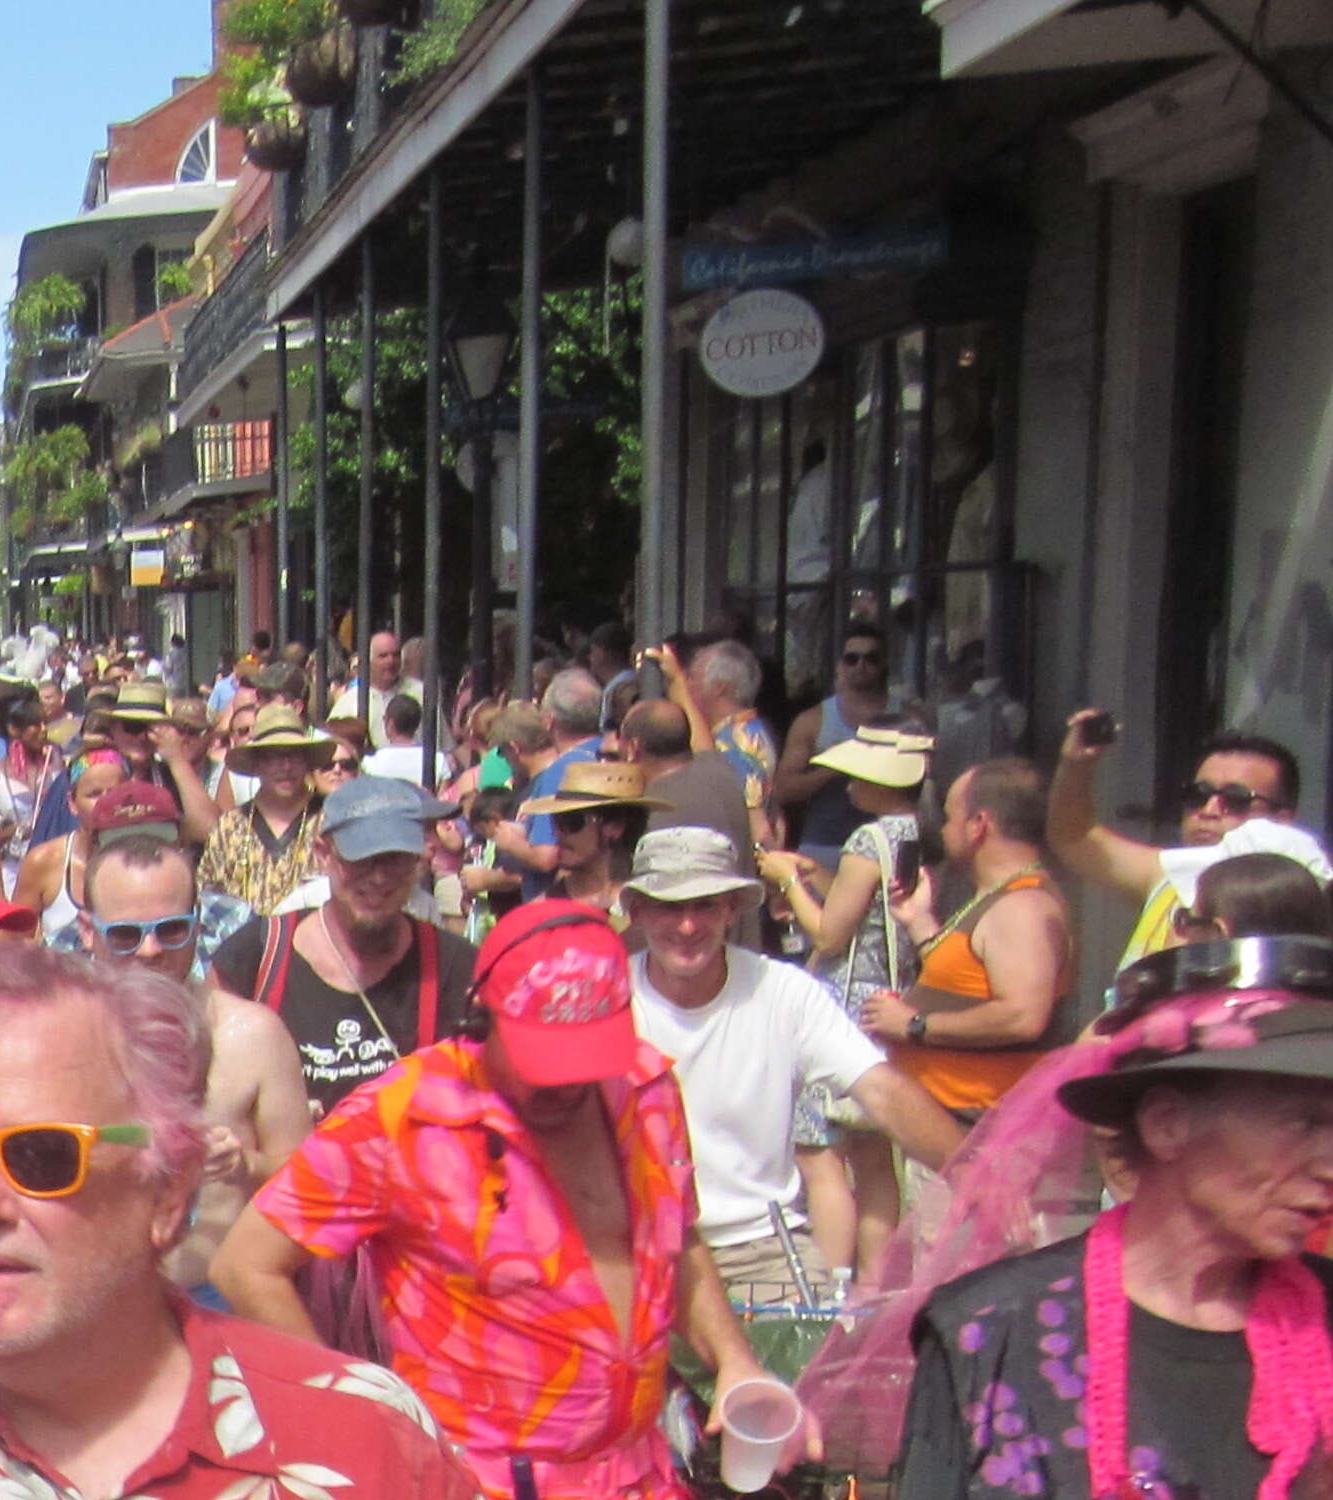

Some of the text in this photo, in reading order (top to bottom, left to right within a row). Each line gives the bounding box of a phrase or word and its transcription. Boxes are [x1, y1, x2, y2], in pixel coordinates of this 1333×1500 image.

[706, 325, 818, 362] COTTON
[313, 1066, 338, 1082] play
[339, 1063, 360, 1077] well
[361, 1060, 386, 1075] with
